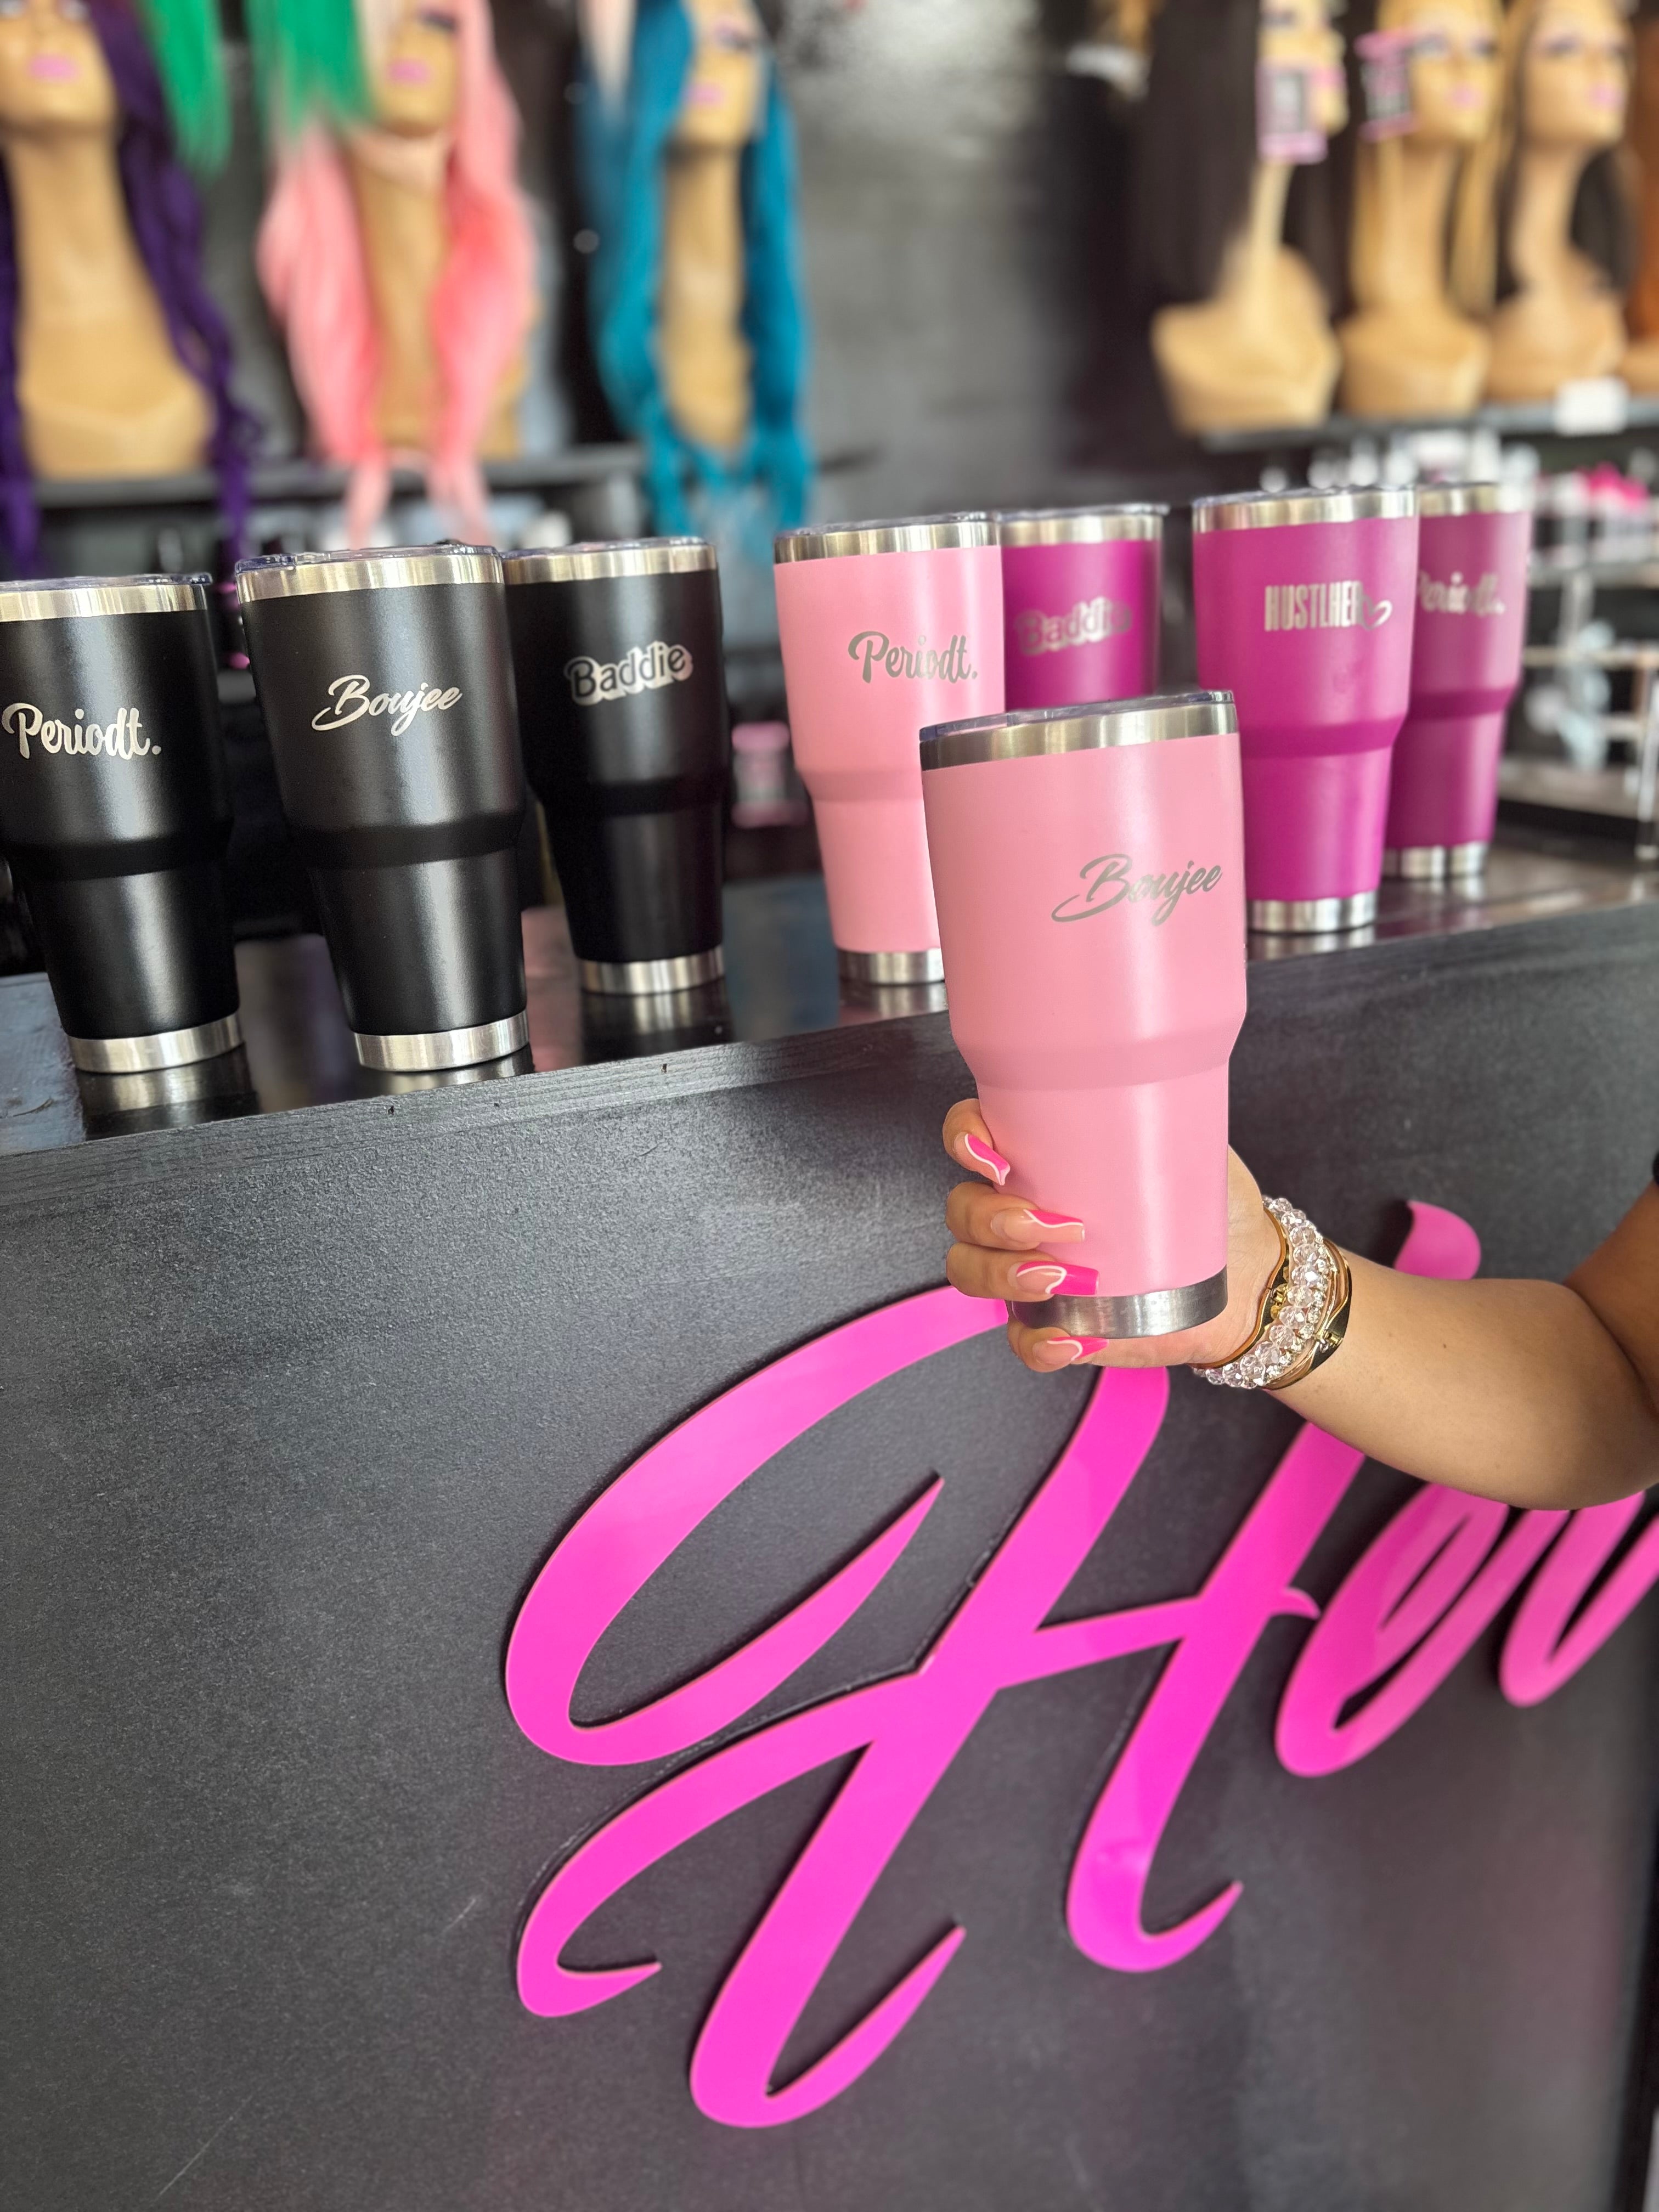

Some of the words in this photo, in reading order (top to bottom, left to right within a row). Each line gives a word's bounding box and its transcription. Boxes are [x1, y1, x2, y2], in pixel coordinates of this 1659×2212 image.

[1015, 596, 1132, 656] Baddie
[565, 641, 693, 706] Baddie
[848, 631, 978, 684] Periodt.
[2, 703, 161, 760] Periodt.
[312, 674, 462, 736] Boujee
[1051, 854, 1223, 927] Boujee
